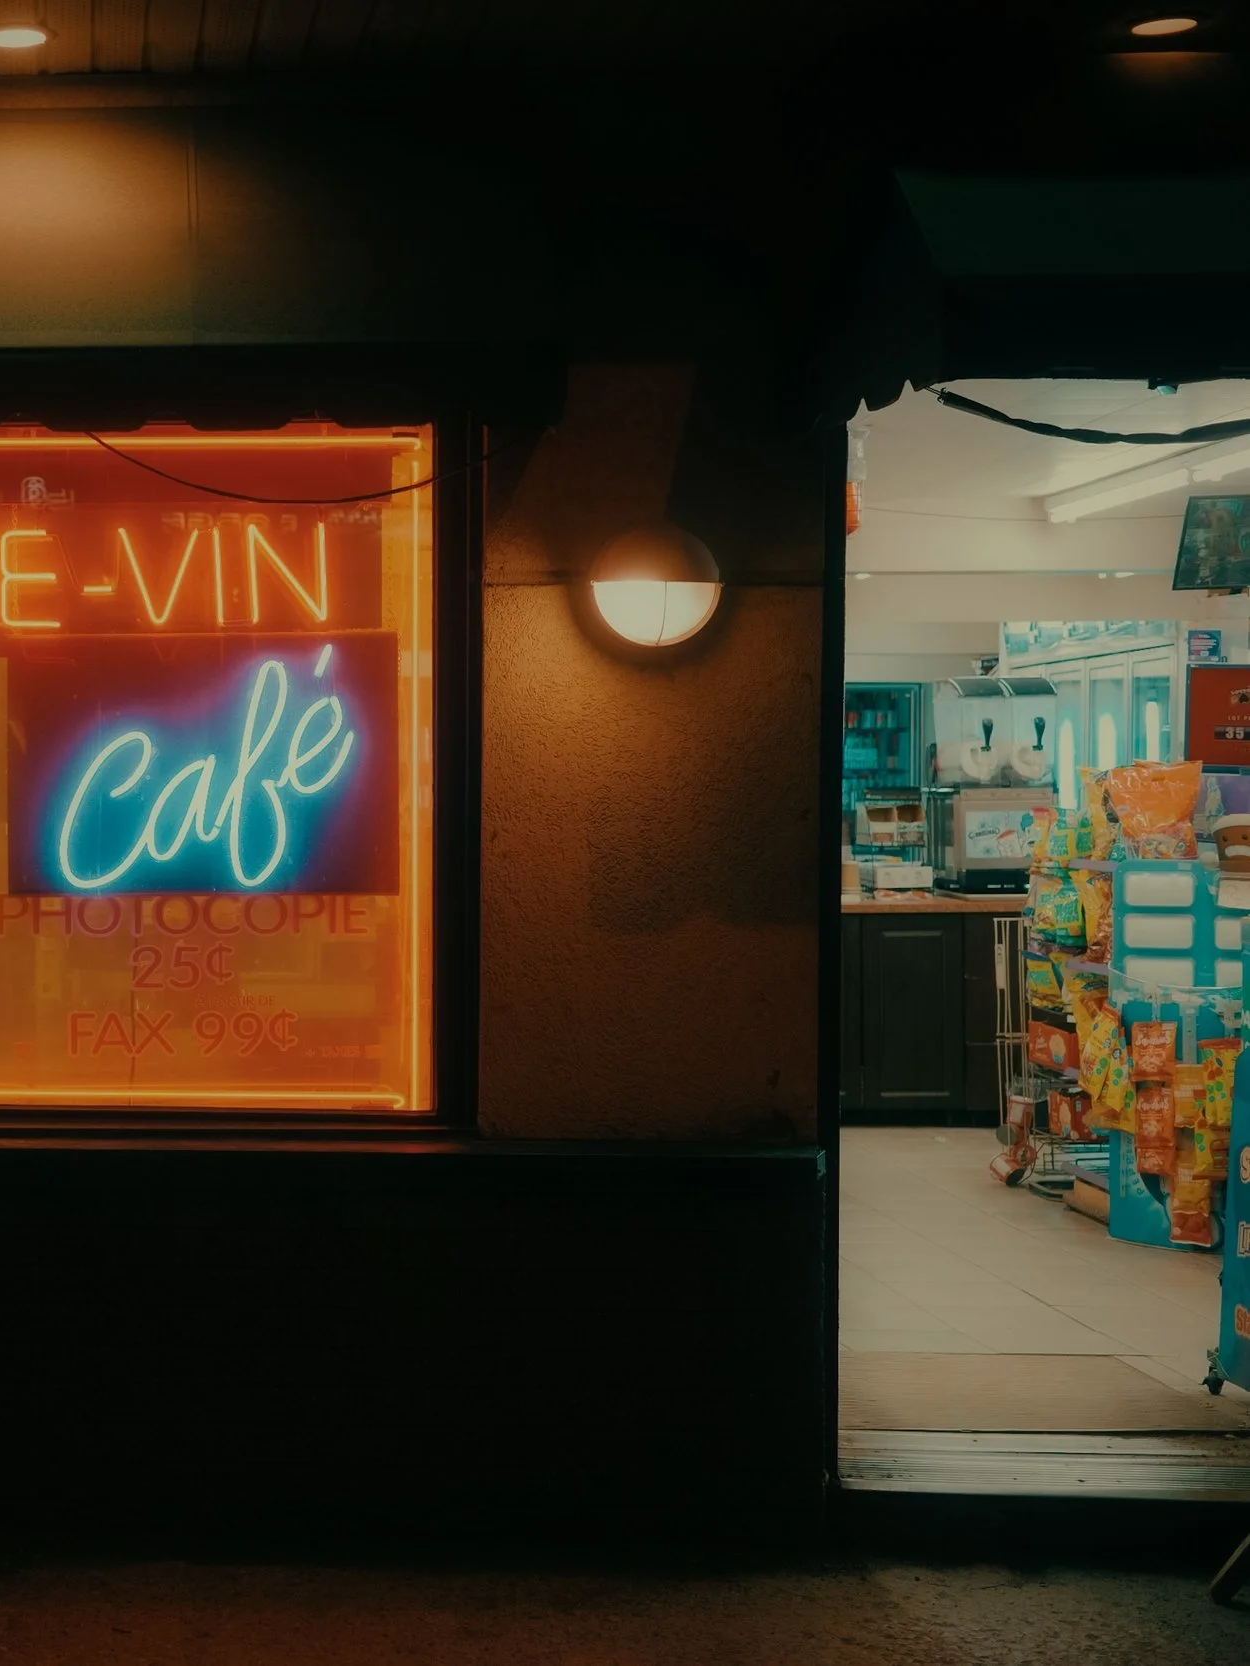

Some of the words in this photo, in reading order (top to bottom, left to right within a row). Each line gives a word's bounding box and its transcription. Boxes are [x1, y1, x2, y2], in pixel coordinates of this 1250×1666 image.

[1225, 726, 1244, 739] 35
[58, 642, 355, 890] Café
[131, 941, 234, 990] 25¢
[68, 1011, 178, 1057] FAX
[193, 1008, 299, 1058] 99¢
